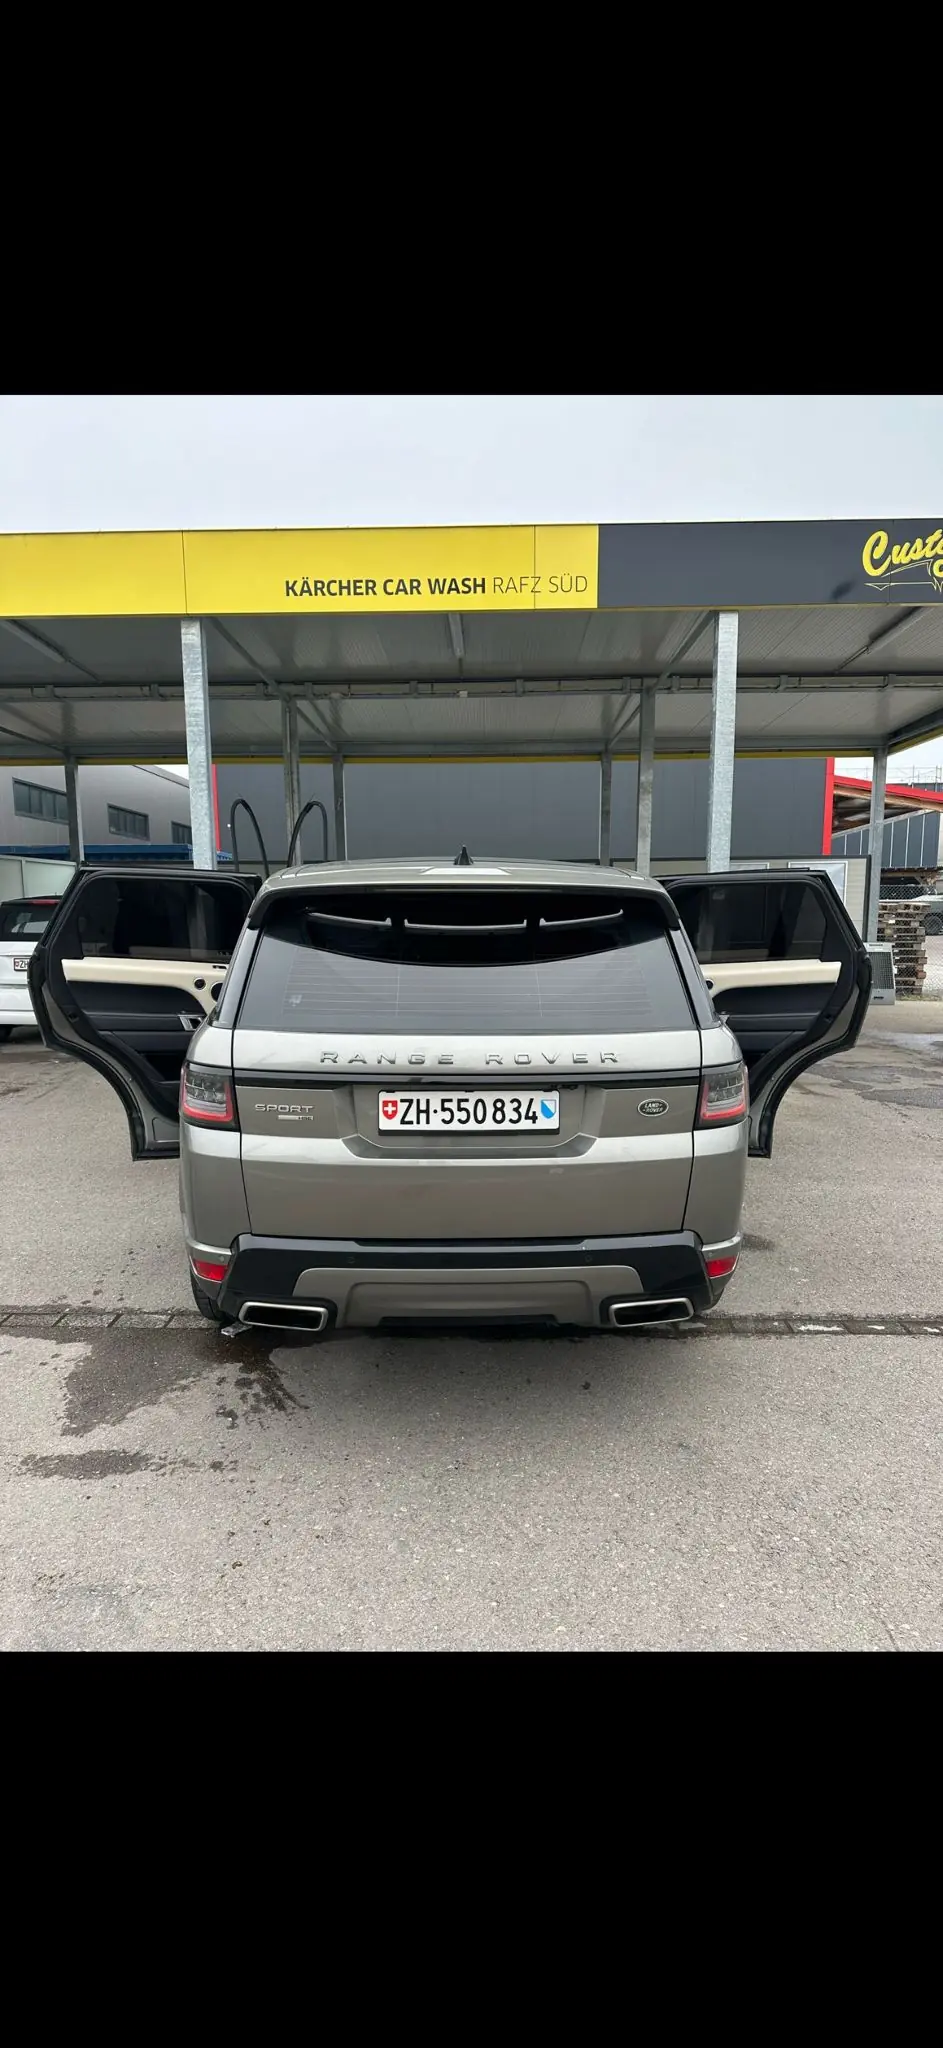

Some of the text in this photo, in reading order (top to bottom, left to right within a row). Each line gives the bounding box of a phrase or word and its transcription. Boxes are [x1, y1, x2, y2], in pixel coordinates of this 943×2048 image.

[285, 573, 588, 597] KÄRCHER CAR WASH RAFZ SÜD
[319, 1051, 619, 1065] RANGE ROVER
[254, 1103, 314, 1113] SPORT
